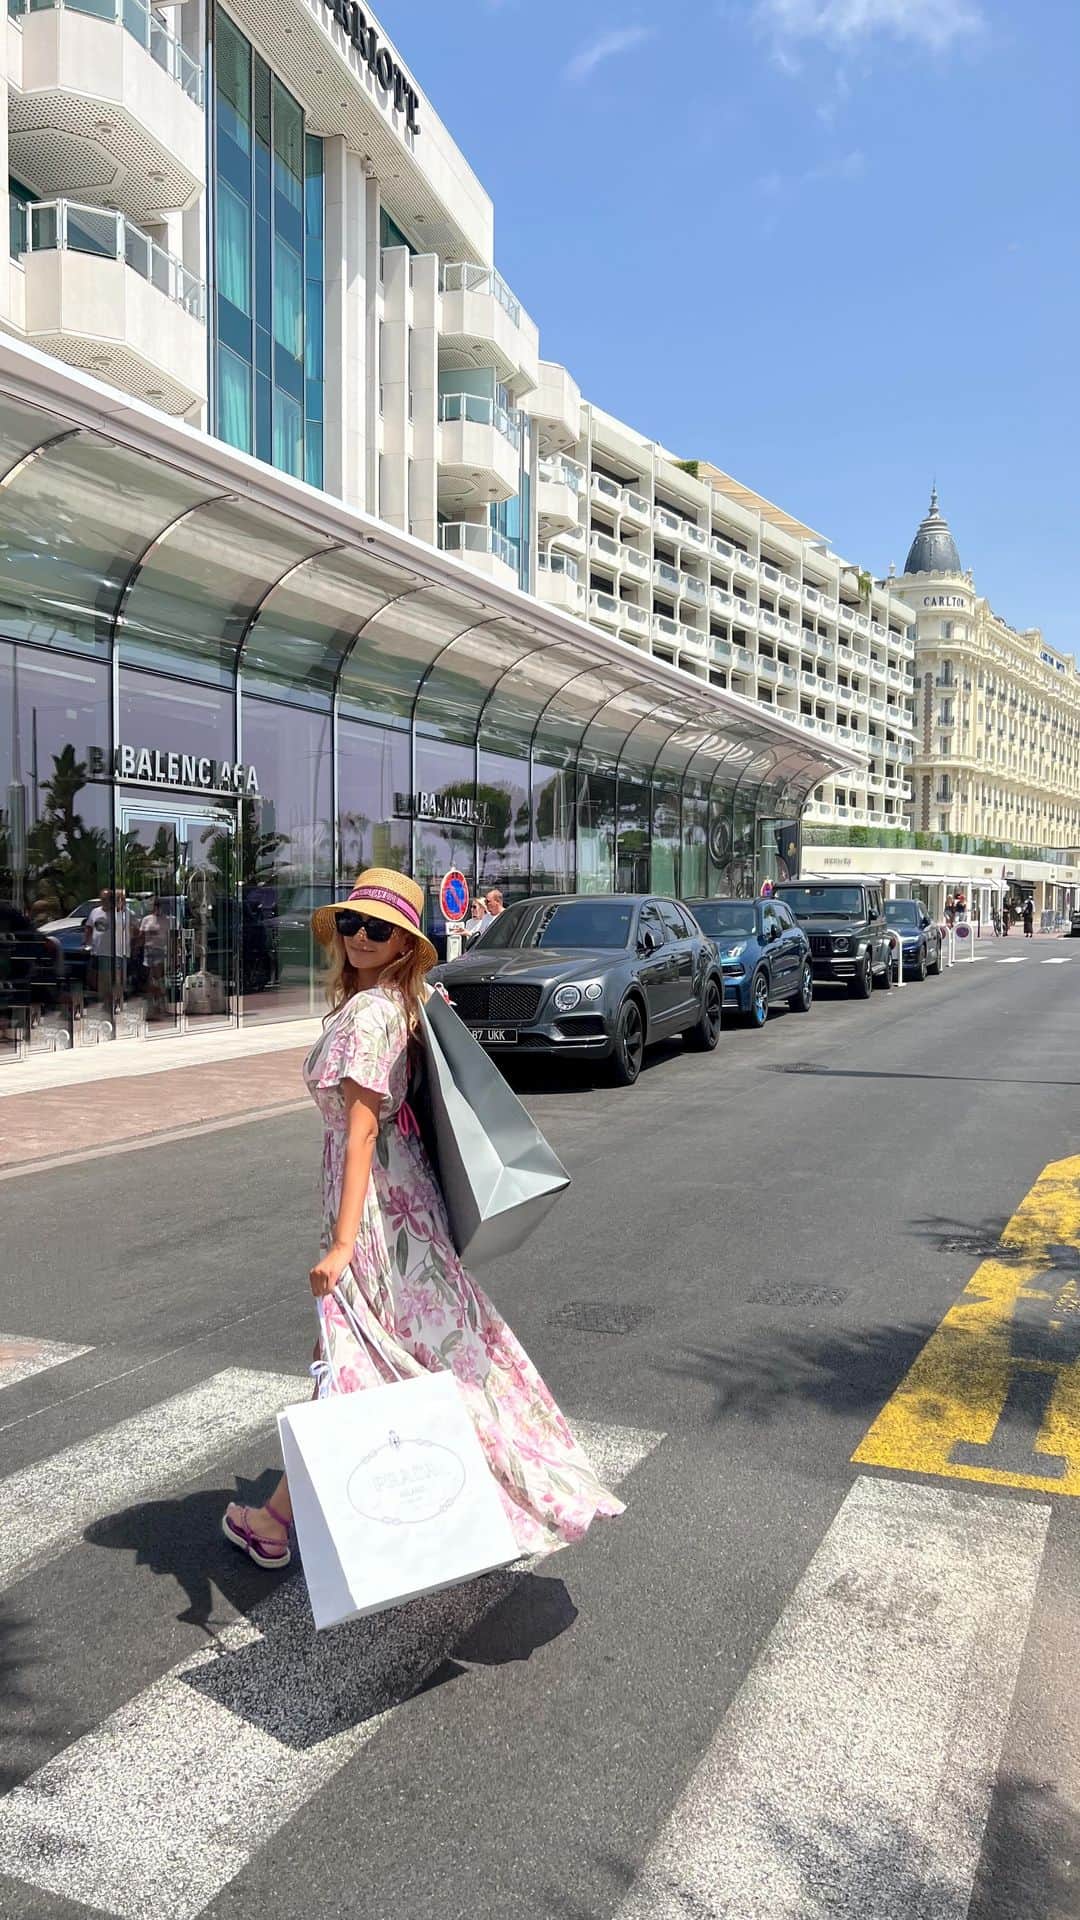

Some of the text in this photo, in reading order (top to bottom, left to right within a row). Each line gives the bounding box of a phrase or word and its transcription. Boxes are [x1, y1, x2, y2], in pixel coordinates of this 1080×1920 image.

[324, 0, 421, 135] RRIOTT
[118, 743, 260, 793] BALENCAGA
[487, 1030, 506, 1041] UKK
